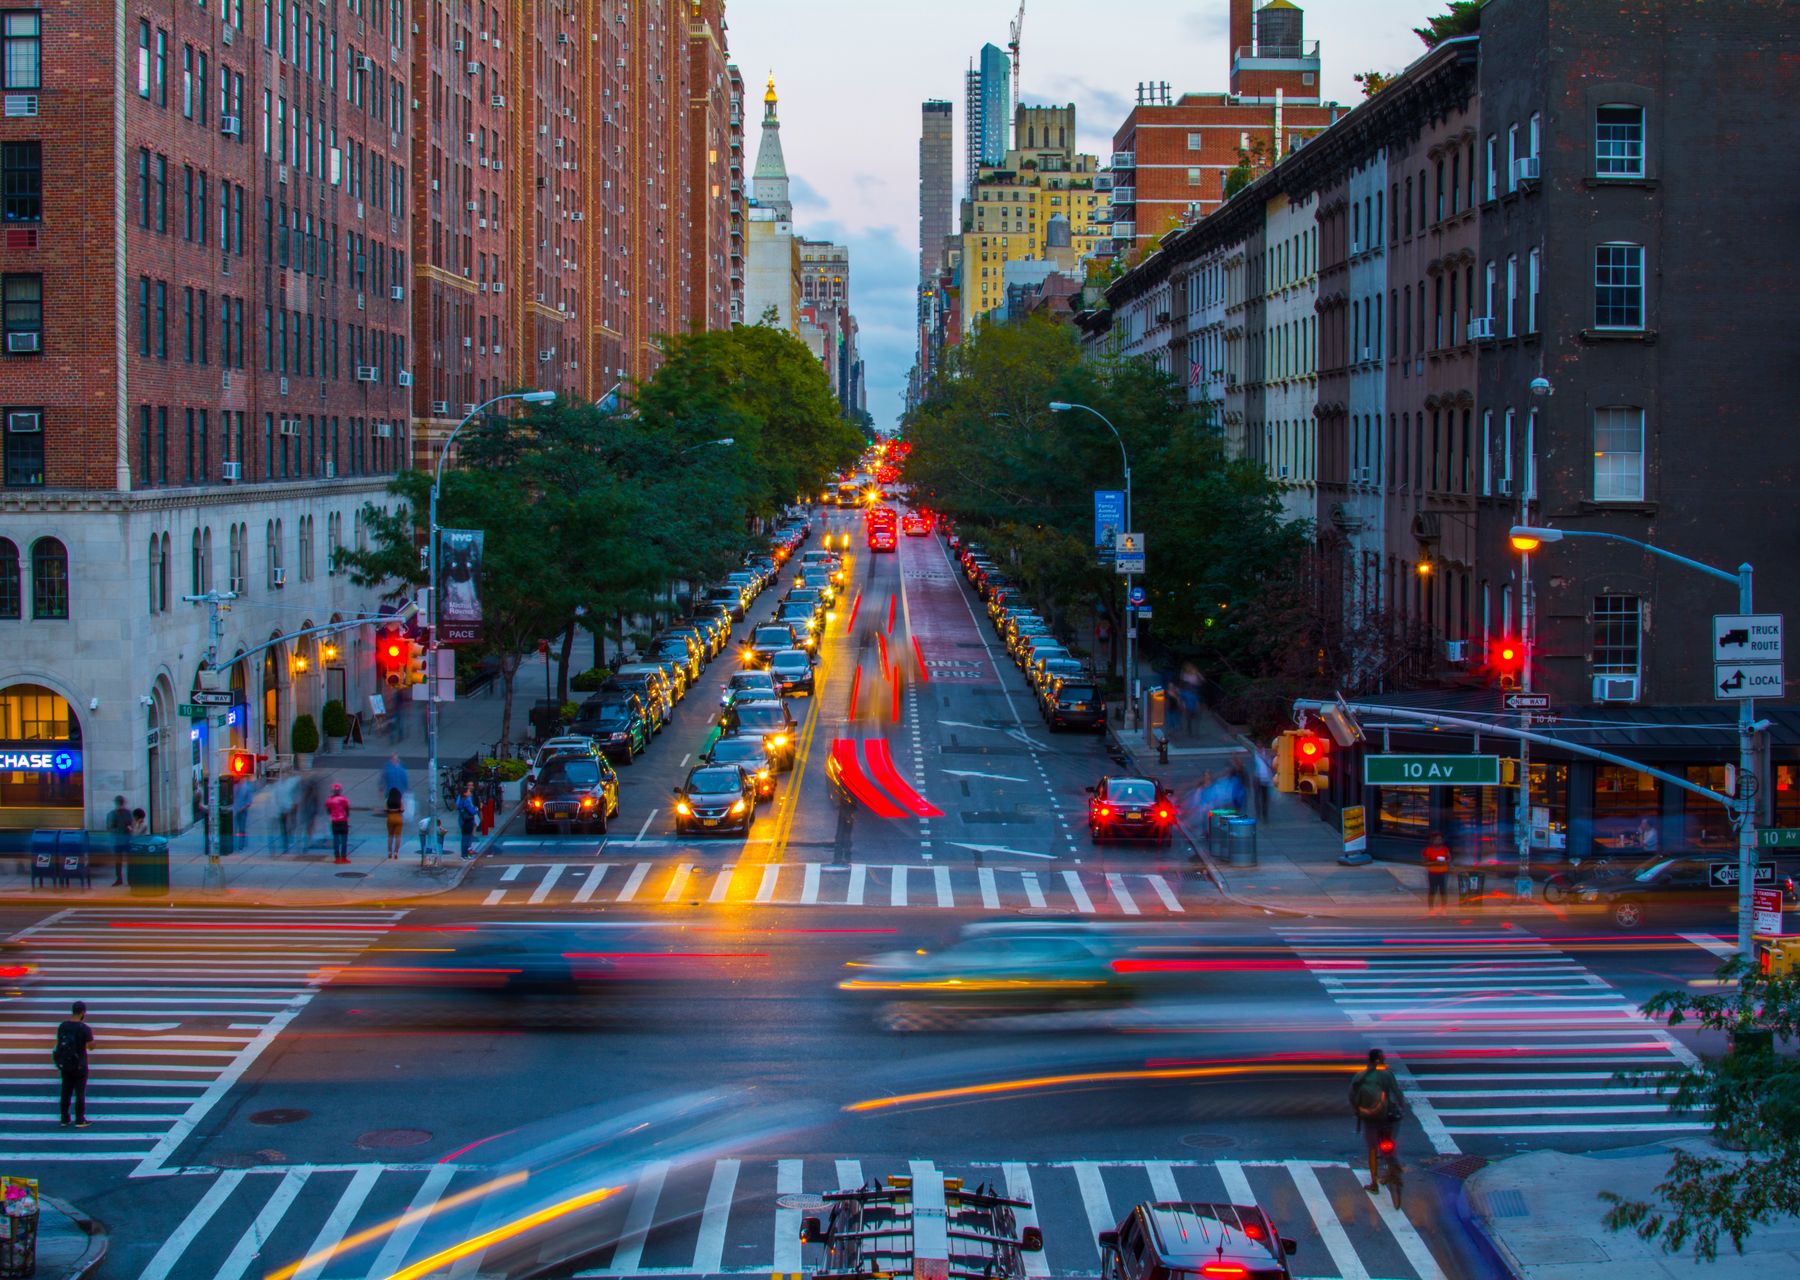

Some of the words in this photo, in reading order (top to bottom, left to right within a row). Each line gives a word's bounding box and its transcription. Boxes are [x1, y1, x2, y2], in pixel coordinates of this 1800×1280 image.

[451, 534, 473, 542] NYC
[449, 630, 474, 638] PACE
[1751, 625, 1779, 635] TRUCK
[1751, 641, 1779, 650] ROUTE
[925, 660, 983, 668] ONLY
[1749, 676, 1781, 685] LOCAL
[183, 706, 192, 715] 10
[1537, 715, 1544, 723] 10
[1403, 763, 1423, 777] 10
[1428, 763, 1454, 777] Av
[1764, 831, 1778, 845] 10
[1720, 870, 1738, 879] ONE
